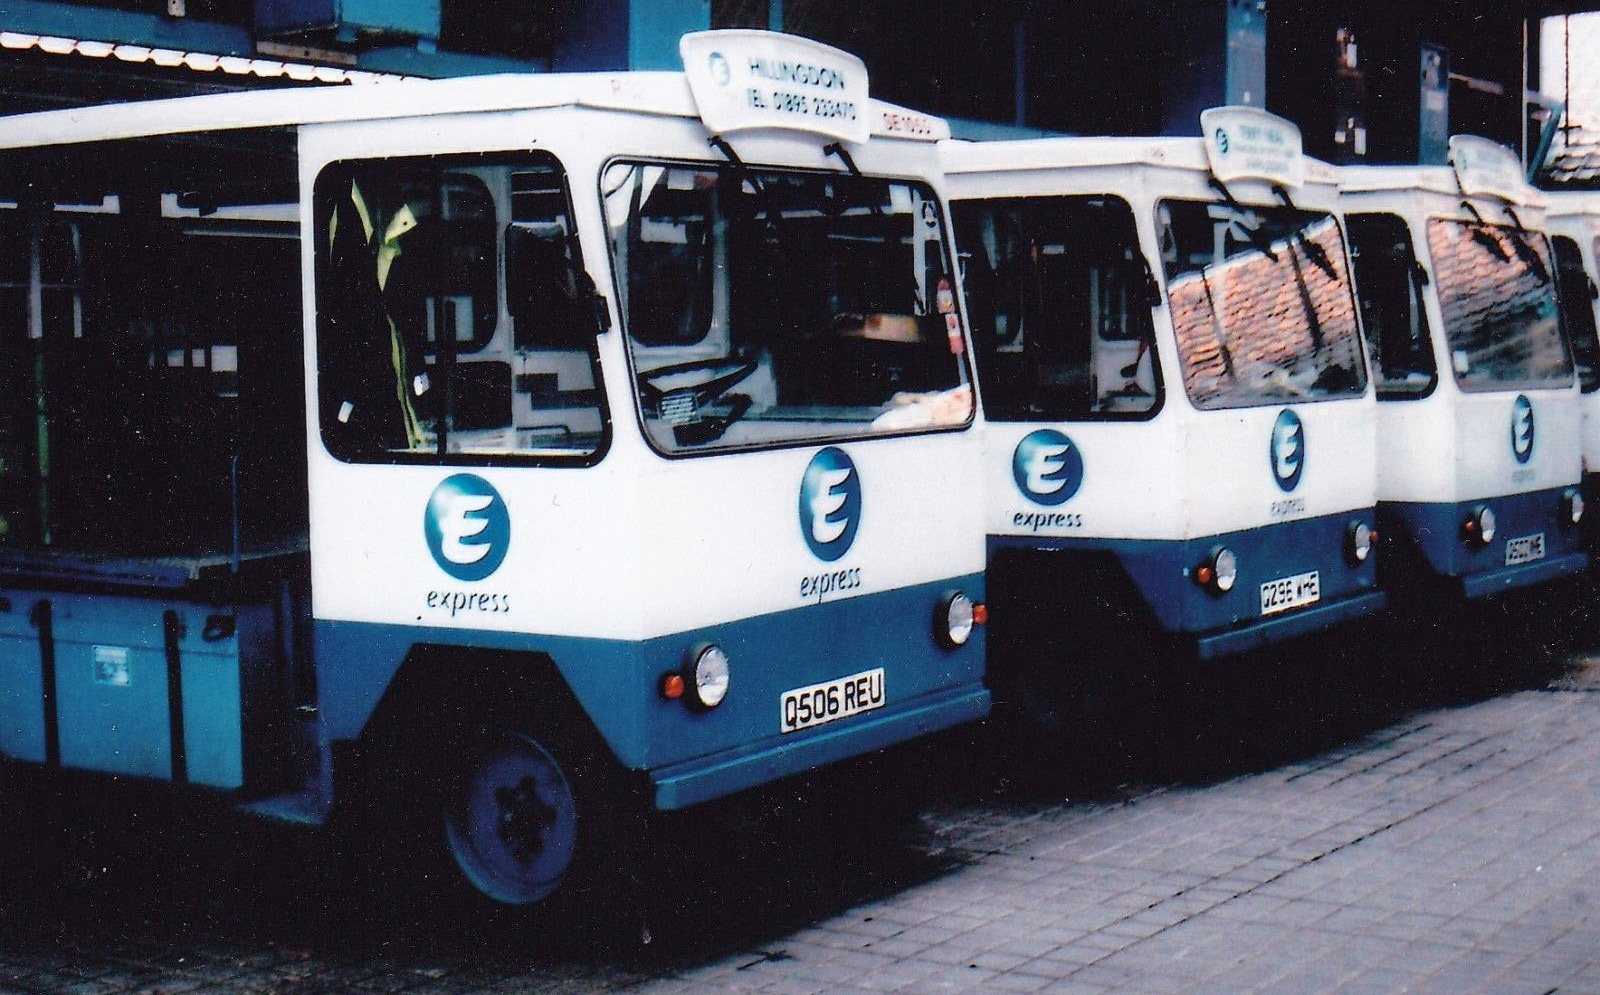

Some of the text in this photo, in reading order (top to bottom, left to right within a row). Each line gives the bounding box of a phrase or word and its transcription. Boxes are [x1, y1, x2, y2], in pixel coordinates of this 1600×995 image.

[748, 58, 846, 90] HILLINGDON
[1013, 512, 1082, 532] express
[800, 568, 861, 604] express
[427, 590, 510, 617] express
[785, 673, 882, 729] Q506 REU
